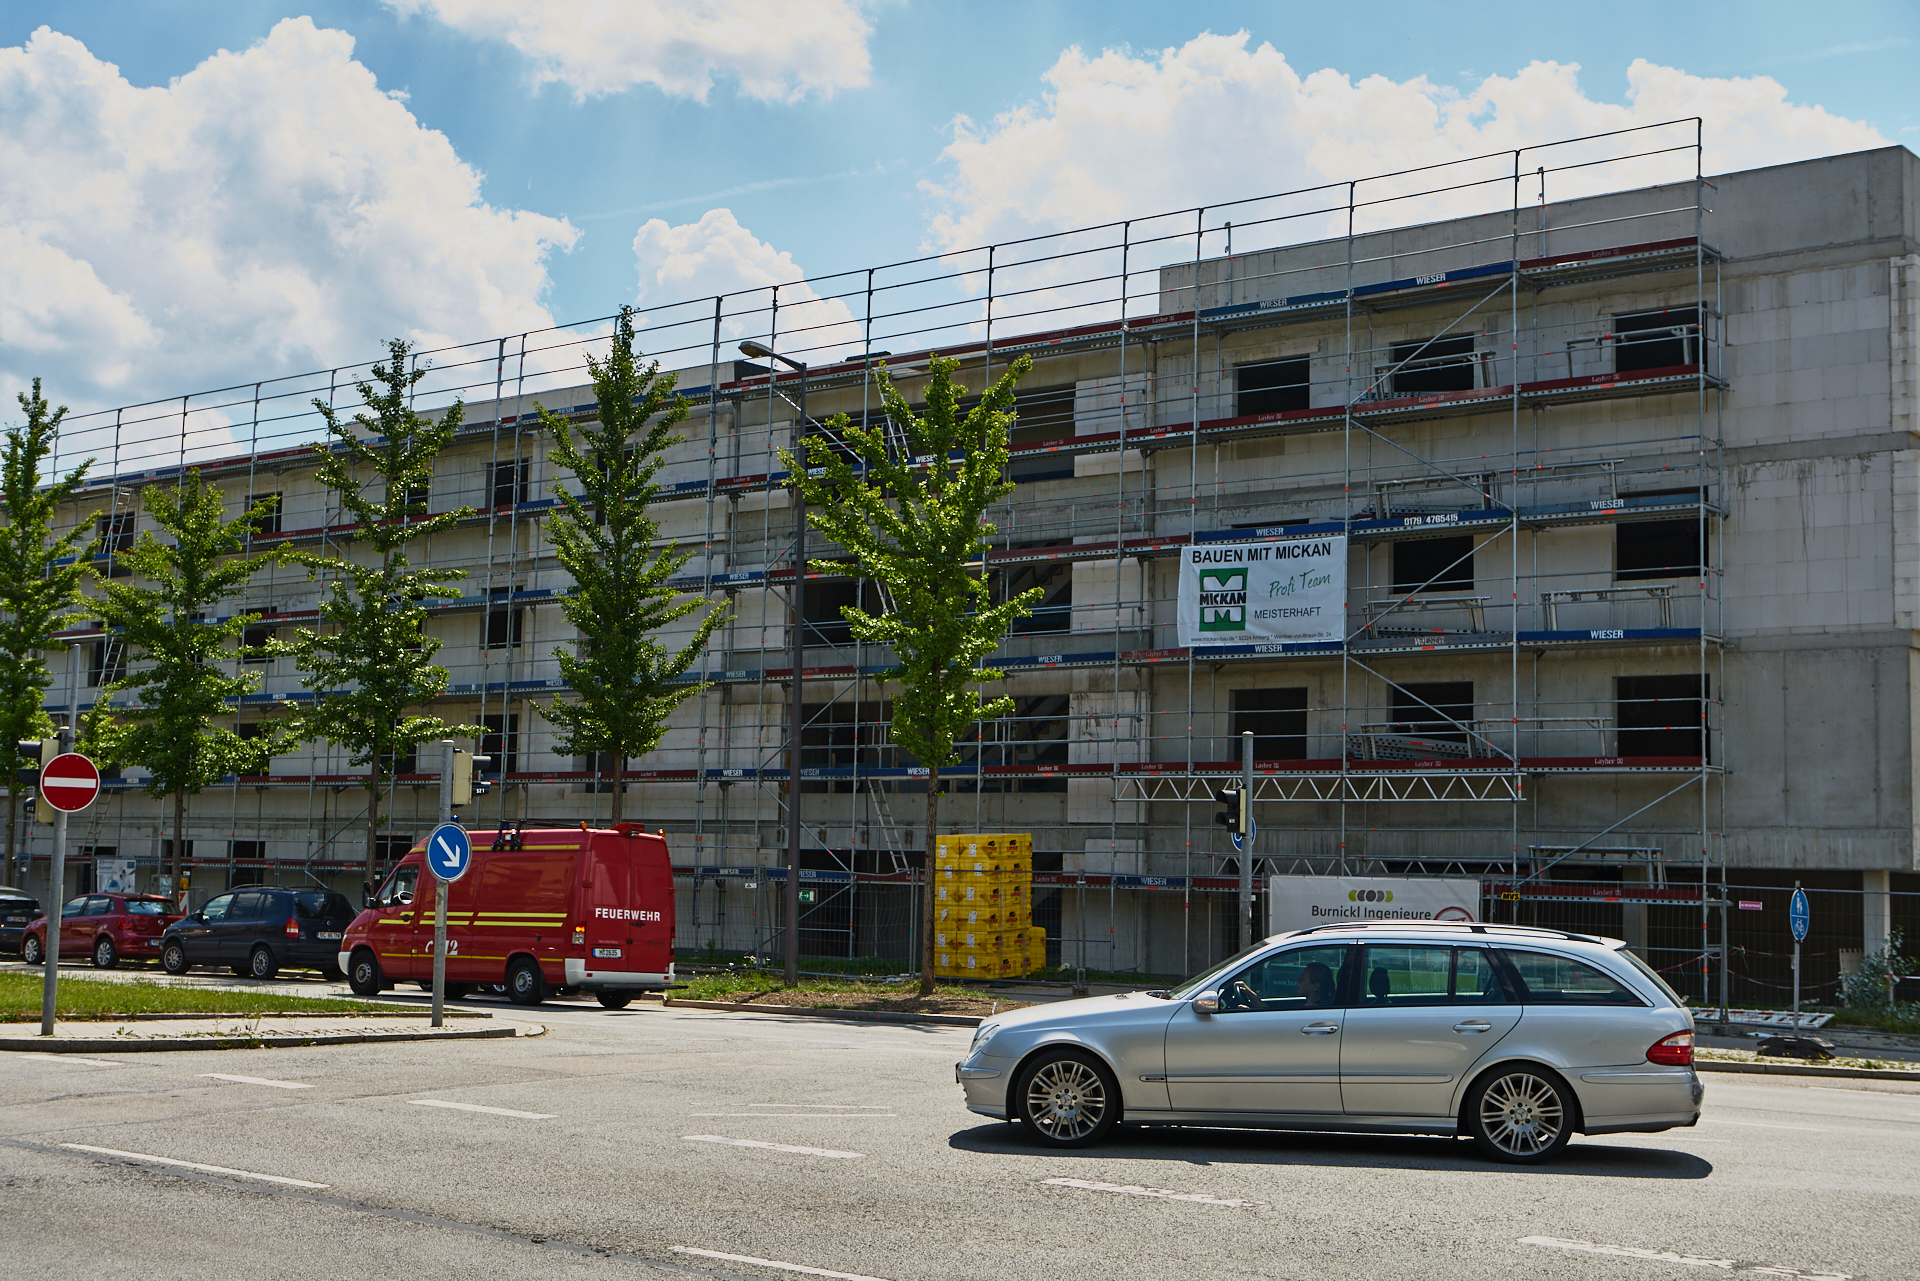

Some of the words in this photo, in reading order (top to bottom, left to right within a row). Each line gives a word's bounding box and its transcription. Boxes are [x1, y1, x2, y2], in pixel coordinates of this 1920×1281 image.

[1416, 273, 1446, 285] WIESER
[1259, 298, 1287, 309] WIESER
[1258, 413, 1275, 421] Layher
[1150, 426, 1167, 434] Layher
[1590, 499, 1624, 510] WIESER
[1404, 513, 1459, 526] 0179/4765415
[1256, 527, 1284, 537] WIESER
[1192, 549, 1243, 563] BAUEN
[1247, 548, 1272, 561] MIT
[1275, 542, 1331, 559] MICKAN
[729, 572, 749, 580] WIESER
[1269, 576, 1296, 598] Profi
[1299, 568, 1330, 590] Team
[1199, 592, 1246, 605] MICKAN
[1254, 606, 1321, 619] MEISTERHAFT
[1590, 630, 1624, 640] WIESER
[1414, 635, 1445, 646] WIESER
[1254, 644, 1283, 653] WIESER
[1038, 655, 1062, 663] WIESER
[726, 670, 746, 678] WIESER
[1415, 760, 1432, 768] Layher
[1594, 757, 1615, 765] Layher
[1141, 762, 1158, 770] Layher
[1255, 762, 1272, 770] Layher
[722, 768, 743, 776] WIESER
[907, 767, 930, 775] WIESER
[799, 870, 817, 878] IESER
[1141, 877, 1167, 886] WIESER
[595, 907, 661, 922] FEUERWEHR
[1311, 905, 1360, 918] Burnickl
[1364, 907, 1431, 920] Ingenieure
